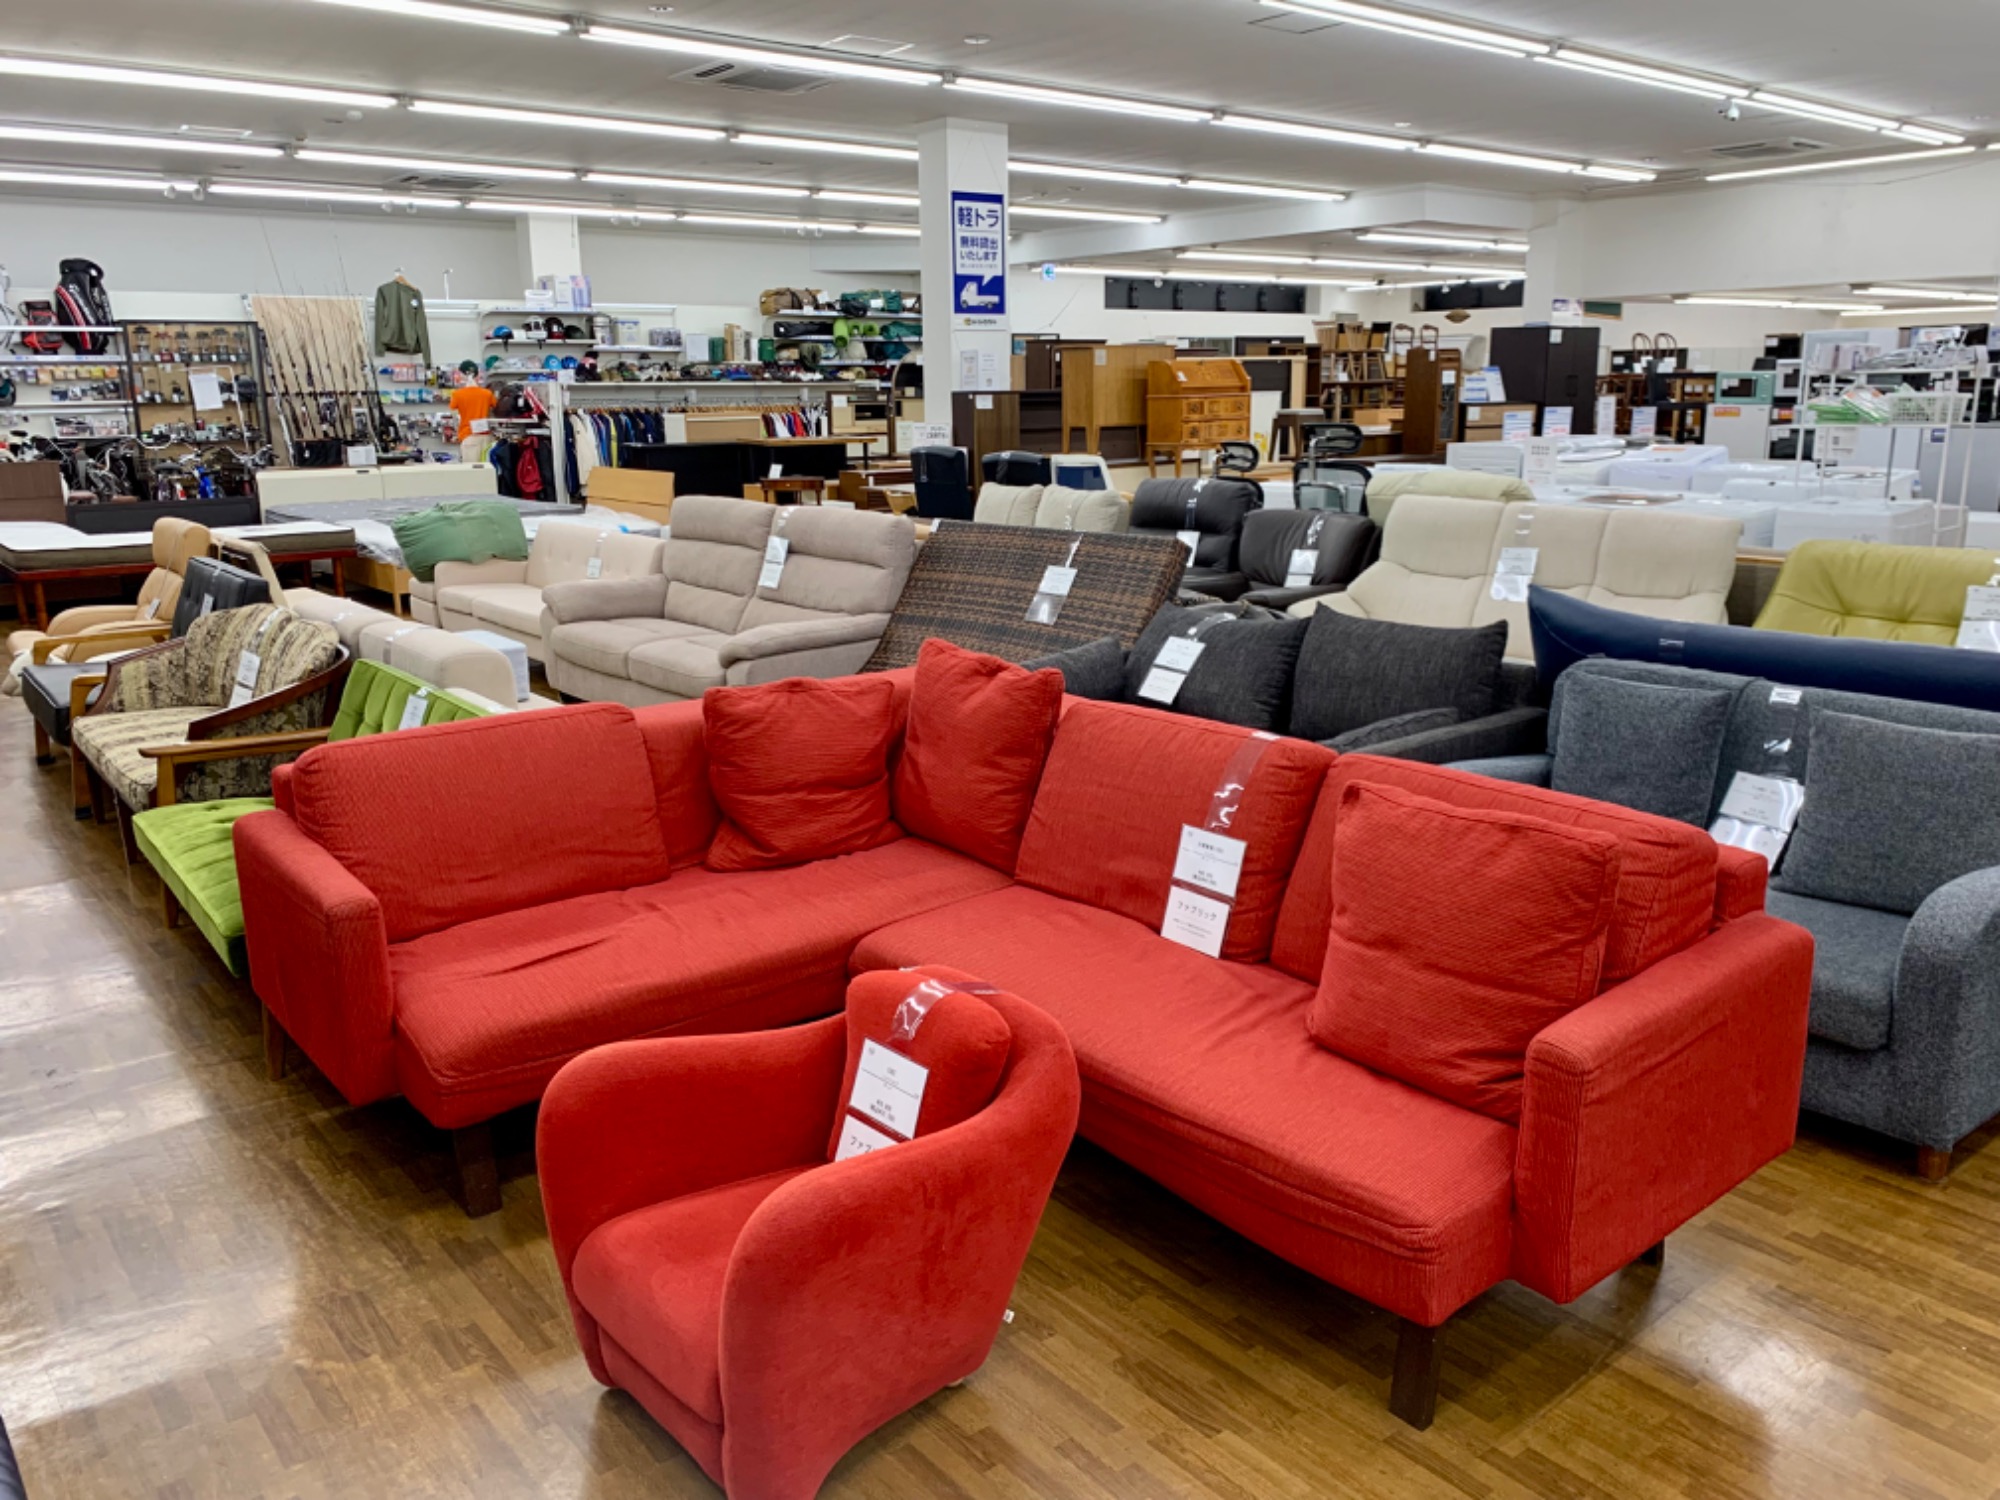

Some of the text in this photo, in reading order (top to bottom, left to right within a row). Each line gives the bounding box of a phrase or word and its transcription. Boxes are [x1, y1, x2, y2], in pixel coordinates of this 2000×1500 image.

[958, 206, 999, 228] 軽トラ
[960, 236, 998, 250] 無料貸出
[960, 250, 997, 261] いたします
[850, 1135, 875, 1153] ファブ
